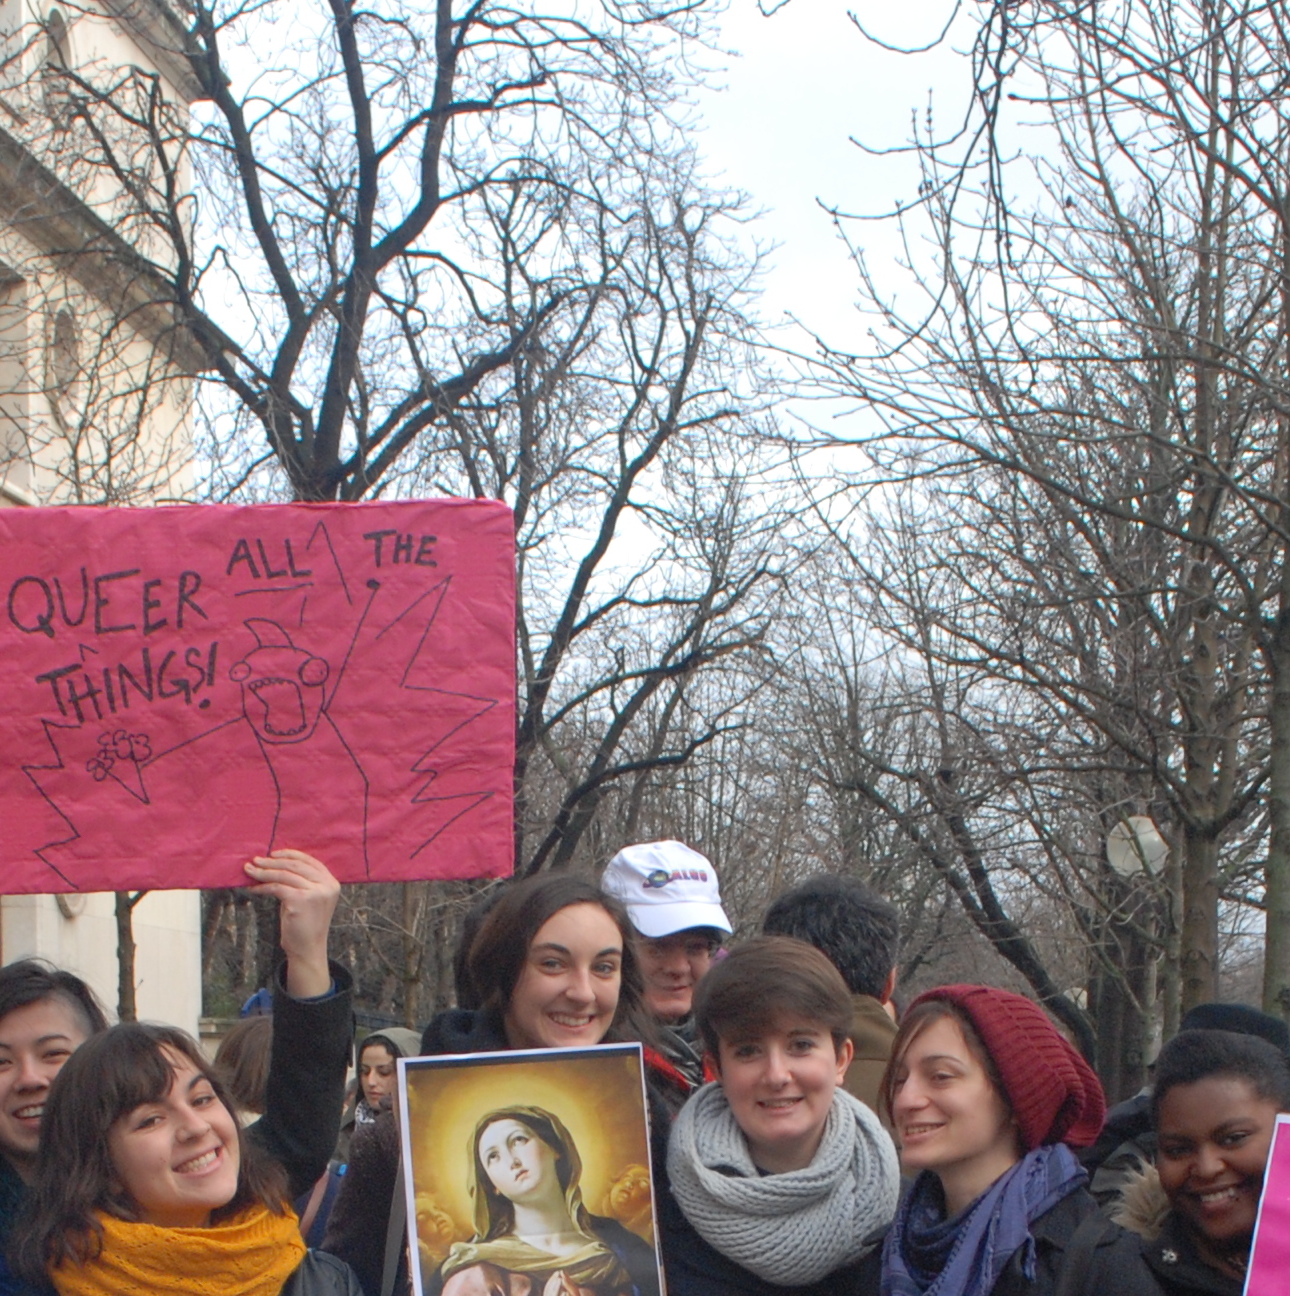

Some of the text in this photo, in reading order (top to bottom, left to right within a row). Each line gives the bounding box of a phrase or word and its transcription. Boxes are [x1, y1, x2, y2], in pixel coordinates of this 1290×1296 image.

[7, 528, 440, 640] QUEER ALL THE
[34, 641, 221, 726] THINGS!
